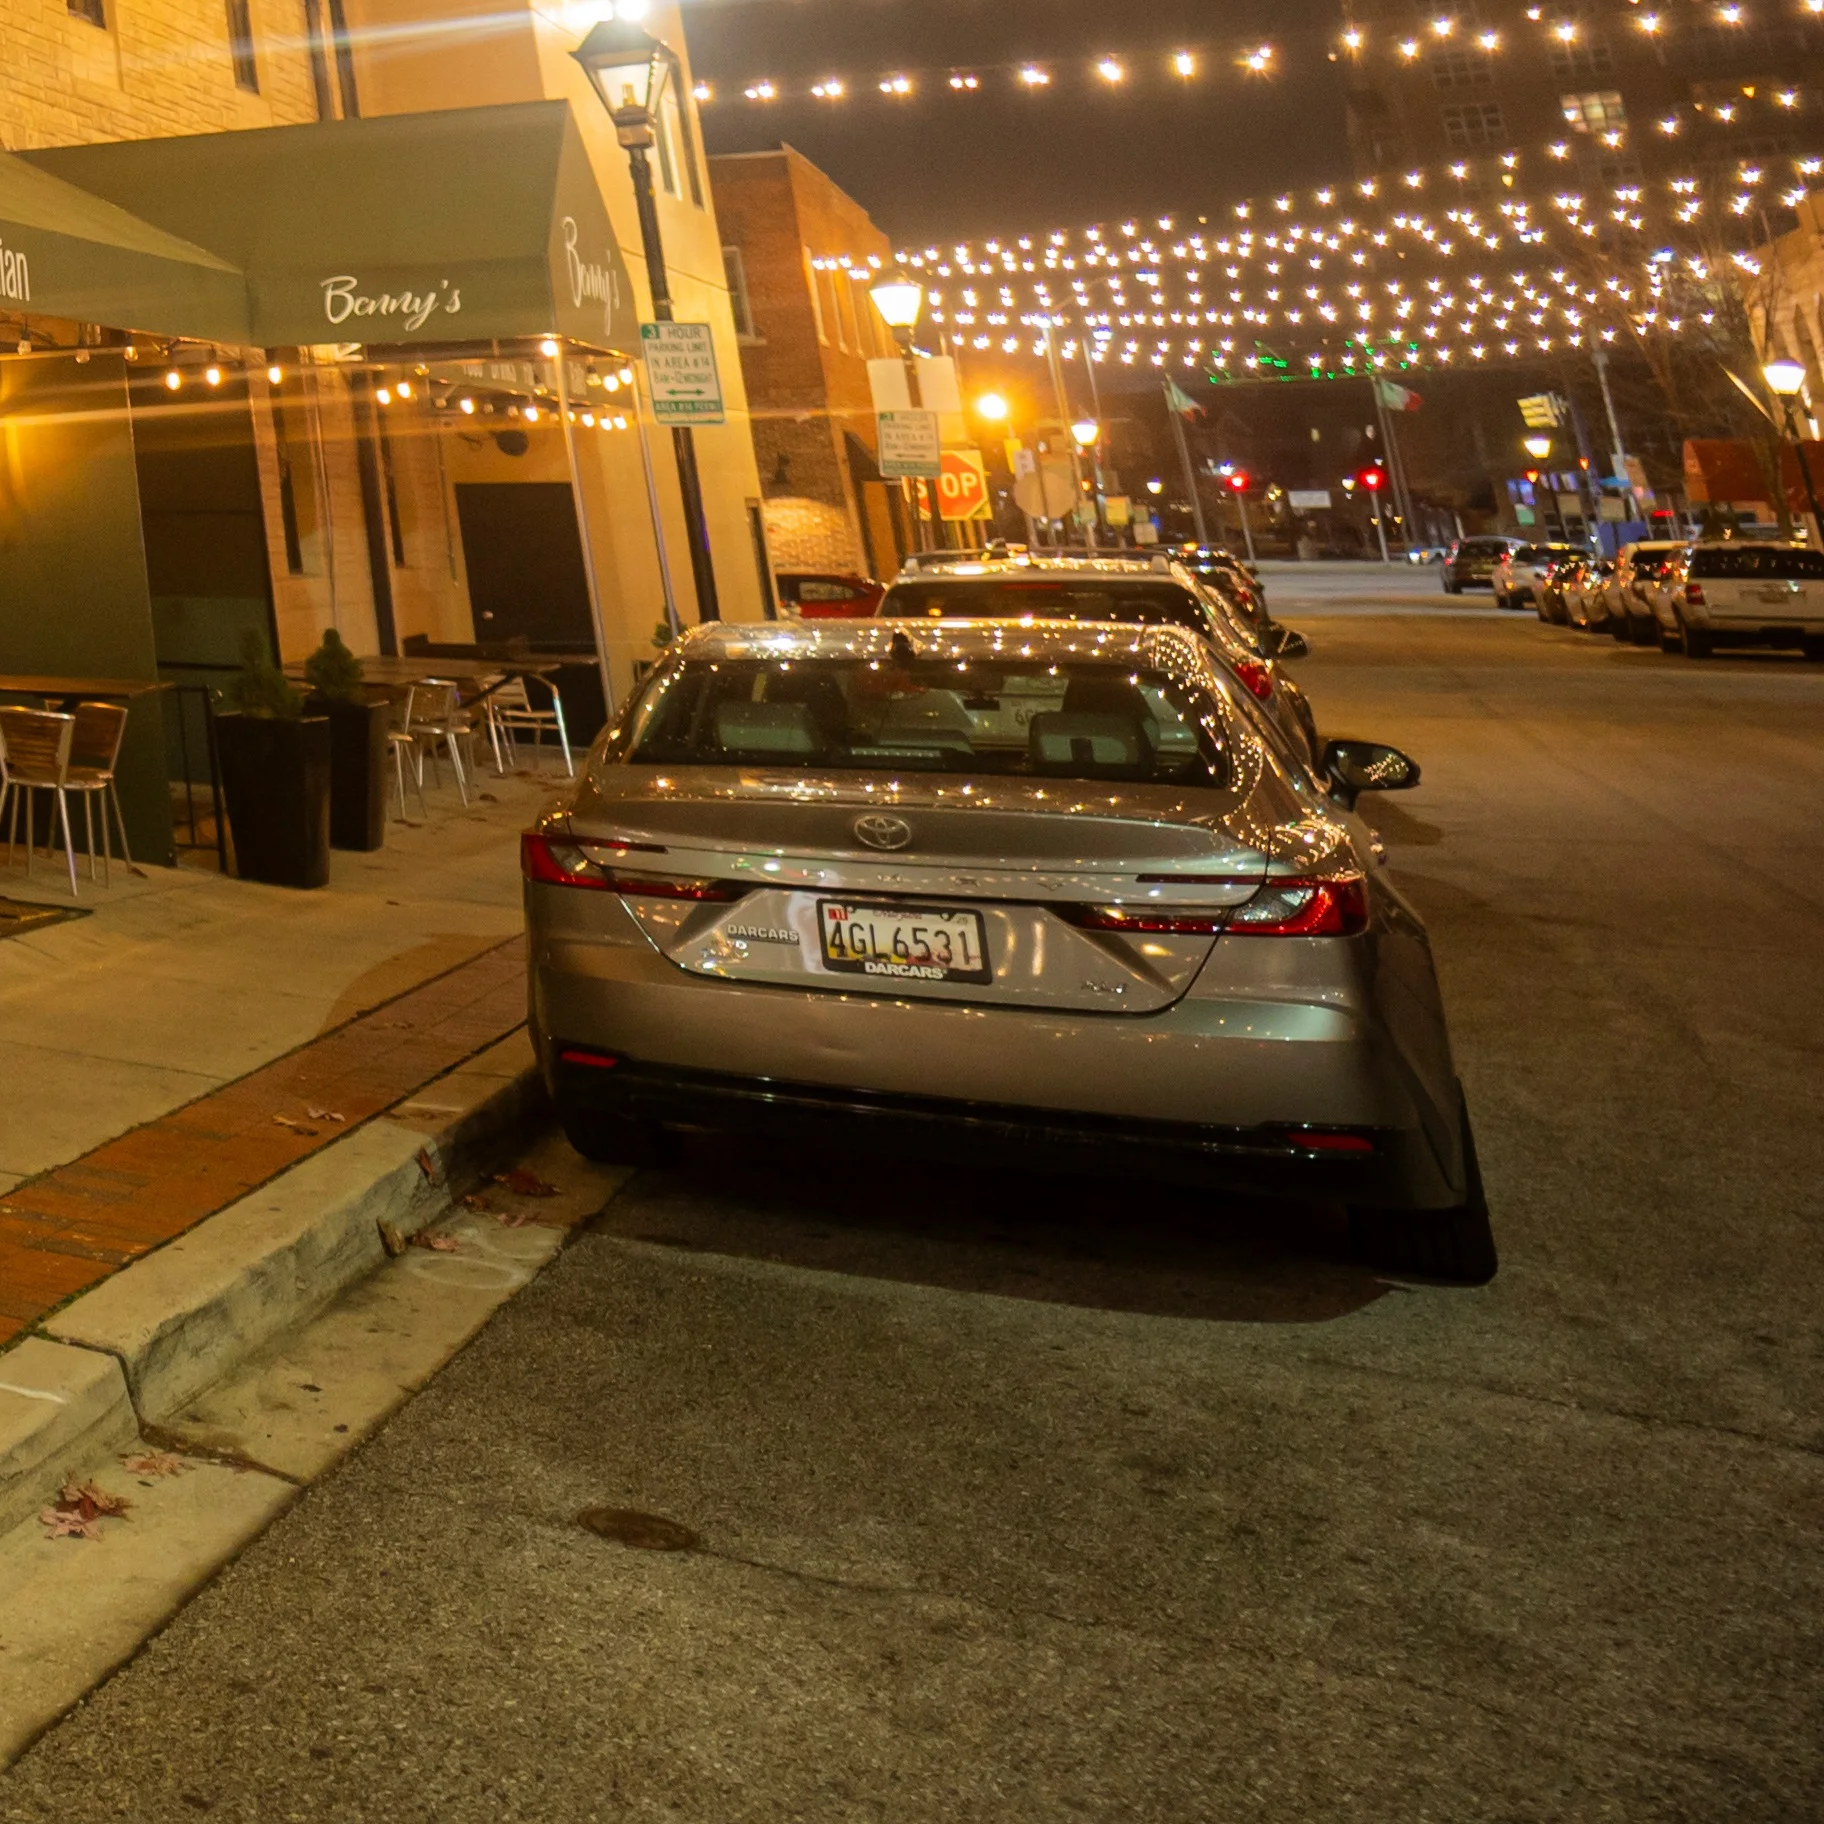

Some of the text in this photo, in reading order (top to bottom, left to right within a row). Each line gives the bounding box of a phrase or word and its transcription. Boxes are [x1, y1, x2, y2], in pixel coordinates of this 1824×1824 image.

[319, 275, 461, 332] Benny's
[728, 924, 799, 943] DARCARS
[830, 921, 971, 966] 4GL6531
[865, 962, 944, 980] DARCARS
